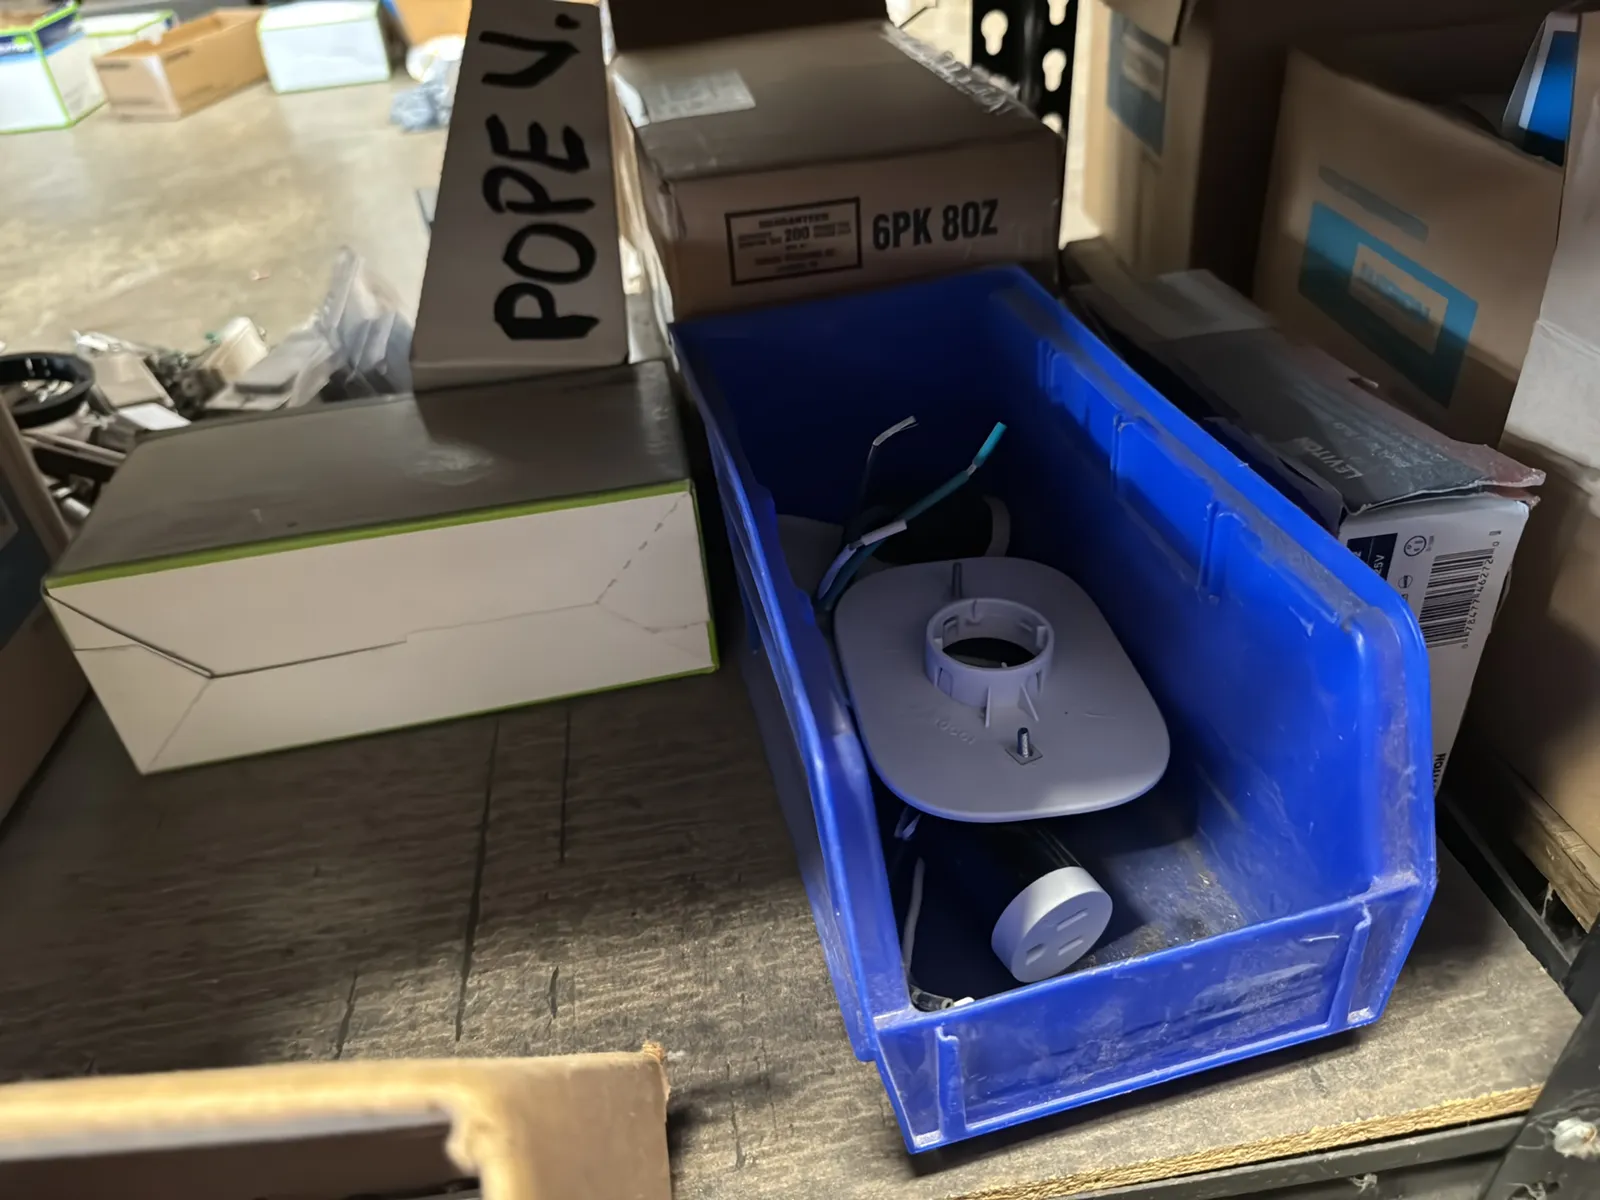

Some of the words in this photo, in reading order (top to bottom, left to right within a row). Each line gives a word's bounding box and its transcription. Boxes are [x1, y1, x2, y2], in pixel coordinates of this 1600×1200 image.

[482, 113, 600, 341] POPE
[872, 207, 933, 251] 6PK
[1301, 437, 1364, 480] LEVITON
